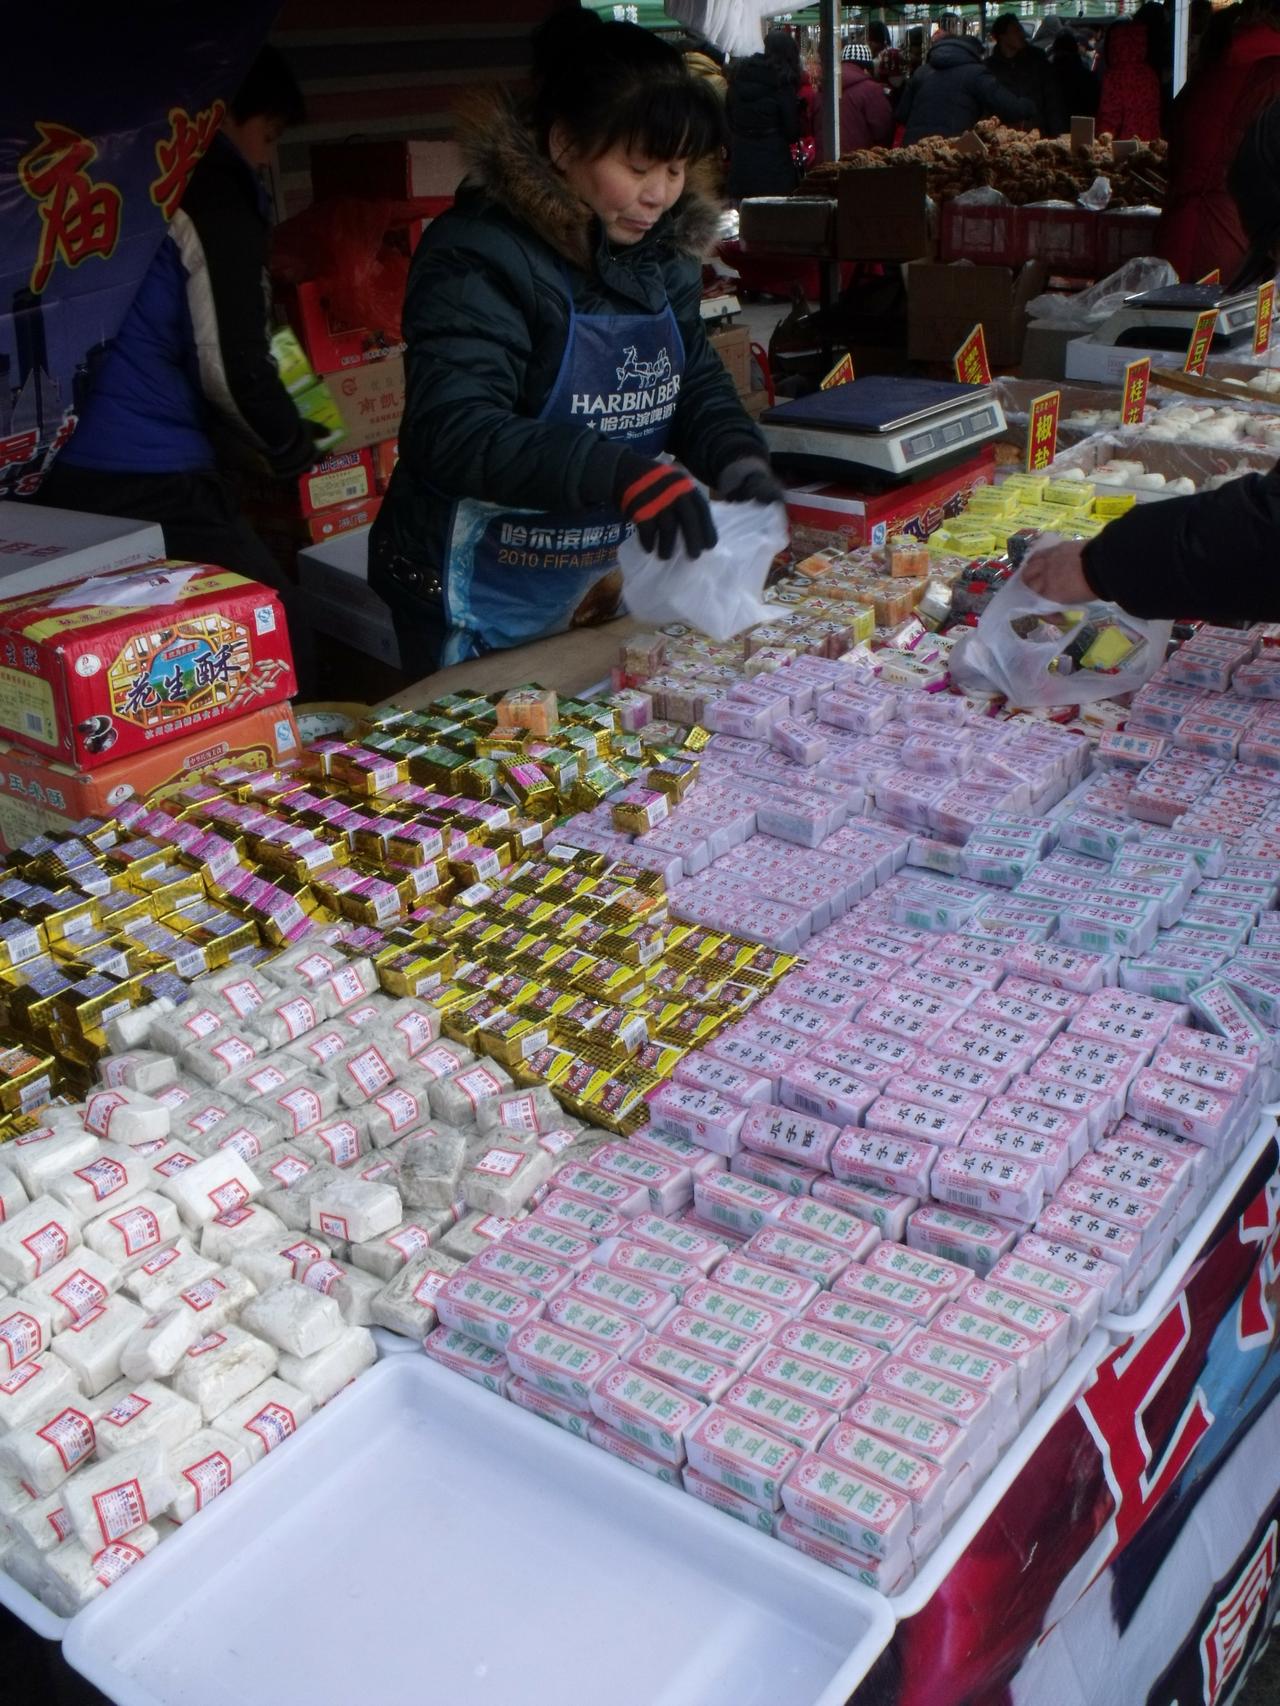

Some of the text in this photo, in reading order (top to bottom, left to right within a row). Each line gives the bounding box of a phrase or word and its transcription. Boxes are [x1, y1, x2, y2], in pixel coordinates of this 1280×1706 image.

[570, 388, 656, 414] HARBIN
[1128, 378, 1144, 424] 桂花
[600, 403, 673, 432] 哈尔滨啤酒
[1035, 414, 1053, 470] 椒盐
[500, 522, 620, 550] 哈尔滨啤酒
[497, 548, 538, 568] 2010
[124, 640, 248, 714] 花生酥
[865, 937, 904, 954] 瓜子酥
[962, 941, 1003, 956] 瓜子酥
[839, 953, 881, 971] 瓜子酥
[944, 956, 986, 973] 瓜子酥
[1034, 948, 1076, 970] 瓜子酥
[826, 970, 866, 988] 瓜子酥
[917, 972, 958, 989] 瓜子酥
[805, 986, 847, 1004] 瓜子酥
[898, 993, 941, 1015] 瓜子酥
[1027, 987, 1070, 1007] 瓜子酥
[780, 1006, 822, 1030] 瓜子酥
[880, 1008, 922, 1033] 瓜子酥
[998, 999, 1041, 1021] 瓜子酥
[1110, 1001, 1155, 1021] 瓜子酥
[1216, 1003, 1254, 1042] 山核桃酥
[758, 1029, 799, 1050] 瓜子酥
[980, 1022, 1025, 1044] 瓜子酥
[1098, 1020, 1144, 1040] 瓜子酥
[862, 1036, 905, 1059] 瓜子酥
[963, 1041, 1008, 1063] 瓜子酥
[1072, 1043, 1118, 1065] 瓜子酥
[1200, 1037, 1247, 1056] 瓜子酥
[697, 1062, 740, 1087] 瓜子酥
[836, 1052, 879, 1072] 瓜子酥
[938, 1063, 983, 1085] 瓜子酥
[1059, 1063, 1106, 1086] 瓜子酥
[1180, 1060, 1228, 1082] 瓜子酥
[814, 1068, 859, 1095] 瓜子酥
[916, 1083, 963, 1104] 瓜子酥
[1038, 1084, 1087, 1105] 瓜子酥
[680, 1094, 725, 1116] 瓜子酥
[1161, 1086, 1210, 1112] 瓜子酥
[898, 1107, 946, 1130] 瓜子酥
[1010, 1104, 1059, 1129] 瓜子酥
[770, 1121, 816, 1148] 瓜子酥
[995, 1131, 1045, 1154] 瓜子酥
[613, 1154, 661, 1178] 绿豆酥
[860, 1141, 909, 1166] 瓜子酥
[1115, 1144, 1164, 1169] 瓜子酥
[963, 1156, 1014, 1181] 瓜子酥
[1102, 1164, 1152, 1189] 瓜子酥
[572, 1171, 620, 1198] 绿豆酥
[717, 1175, 767, 1199] 绿豆酥
[559, 1202, 610, 1229] 绿豆酥
[1089, 1191, 1140, 1217] 瓜子酥
[801, 1203, 853, 1237] 绿豆酥
[934, 1211, 992, 1237] 绿豆酥
[1069, 1214, 1120, 1240] 瓜子酥
[528, 1226, 578, 1253] 绿豆酥
[648, 1220, 696, 1249] 绿豆酥
[775, 1237, 830, 1263] 绿豆酥
[1047, 1245, 1099, 1273] 瓜子酥
[497, 1253, 549, 1280] 绿豆酥
[634, 1252, 685, 1275] 绿豆酥
[891, 1253, 945, 1282] 绿豆酥
[592, 1275, 647, 1305] 绿豆酥
[733, 1267, 789, 1295] 绿豆酥
[862, 1274, 919, 1303] 绿豆酥
[1012, 1263, 1070, 1294] 绿豆酥
[464, 1281, 518, 1313] 绿豆酥
[986, 1289, 1043, 1325] 绿豆酥
[566, 1304, 621, 1336] 绿豆酥
[705, 1294, 761, 1328] 绿豆酥
[833, 1303, 891, 1330] 绿豆酥
[690, 1320, 747, 1351] 绿豆酥
[959, 1315, 1018, 1348] 绿豆酥
[535, 1334, 591, 1368] 绿豆酥
[801, 1332, 859, 1364] 绿豆酥
[657, 1349, 715, 1382] 绿豆酥
[929, 1345, 990, 1378] 绿豆酥
[780, 1360, 840, 1394] 绿豆酥
[902, 1370, 963, 1405] 绿豆酥
[624, 1379, 680, 1418] 绿豆酥
[747, 1388, 807, 1423] 绿豆酥
[872, 1405, 935, 1441] 绿豆酥
[724, 1426, 786, 1467] 绿豆酥
[853, 1438, 916, 1481] 绿豆酥
[819, 1471, 883, 1515] 绿豆酥
